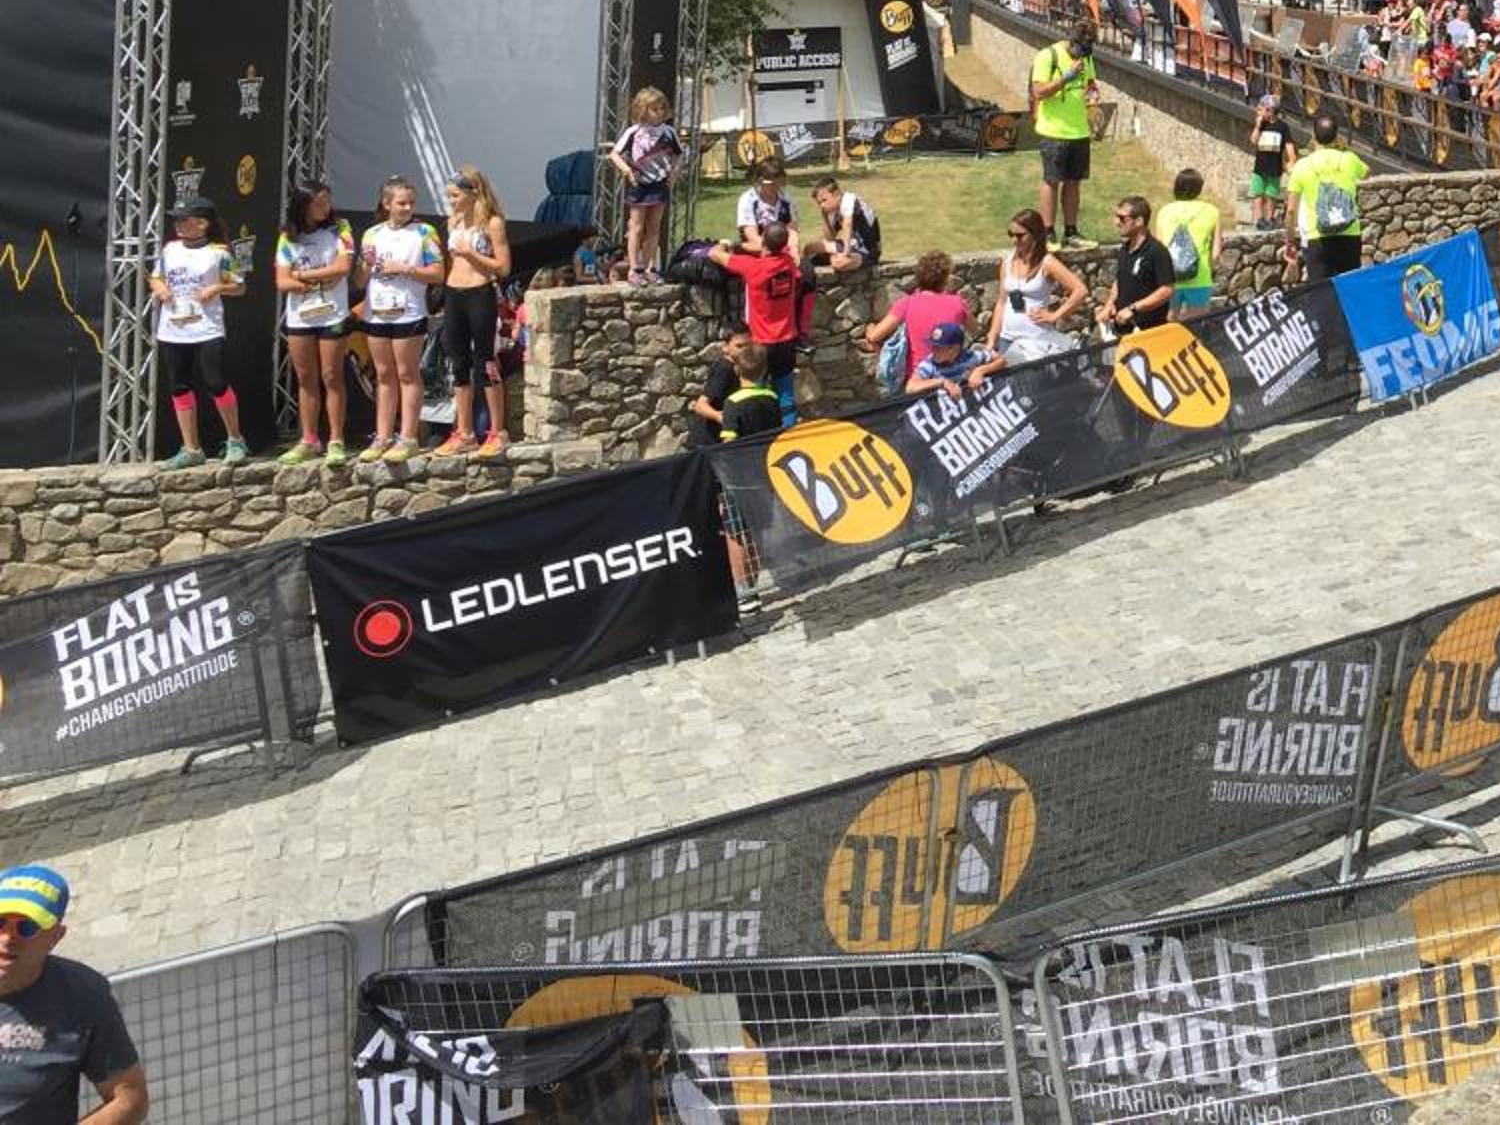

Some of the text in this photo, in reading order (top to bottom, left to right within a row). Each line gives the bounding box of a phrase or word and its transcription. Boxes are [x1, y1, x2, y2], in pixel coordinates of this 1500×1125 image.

[756, 52, 841, 69] PUBLIC ACCESS
[1224, 290, 1289, 352] FLAT IS
[1243, 310, 1315, 387] BORING
[930, 385, 1027, 477] BORING
[53, 571, 201, 662] FLAT IS
[421, 526, 698, 633] LEDLENSER
[56, 649, 240, 742] #CHANGEYOURATTITUDE
[59, 596, 237, 711] BORING
